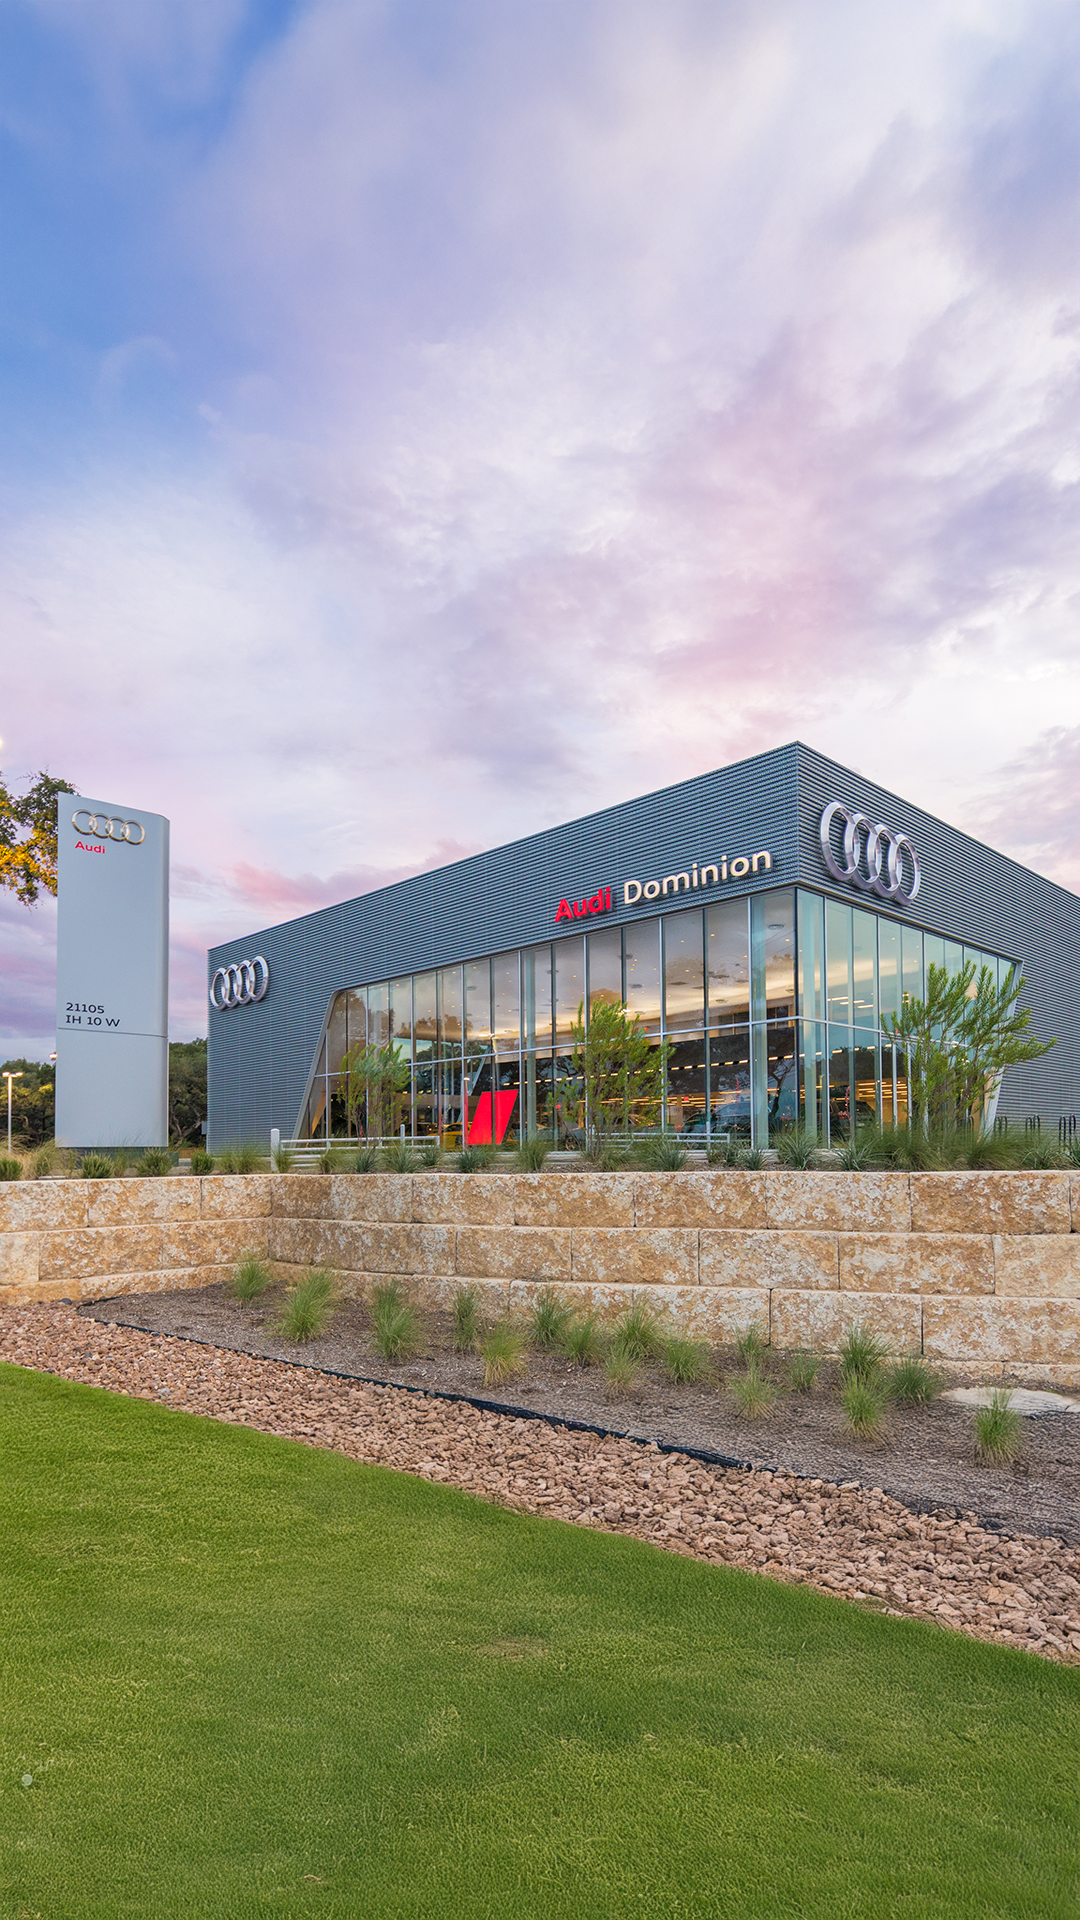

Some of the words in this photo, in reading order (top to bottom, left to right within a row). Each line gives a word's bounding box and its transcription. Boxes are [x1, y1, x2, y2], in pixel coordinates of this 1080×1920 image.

[75, 841, 106, 854] Audi
[554, 886, 611, 922] Audi
[624, 850, 771, 904] Dominion
[66, 1002, 105, 1014] 21105
[66, 1015, 82, 1024] IH
[87, 1016, 102, 1026] 10
[105, 1018, 121, 1027] W
